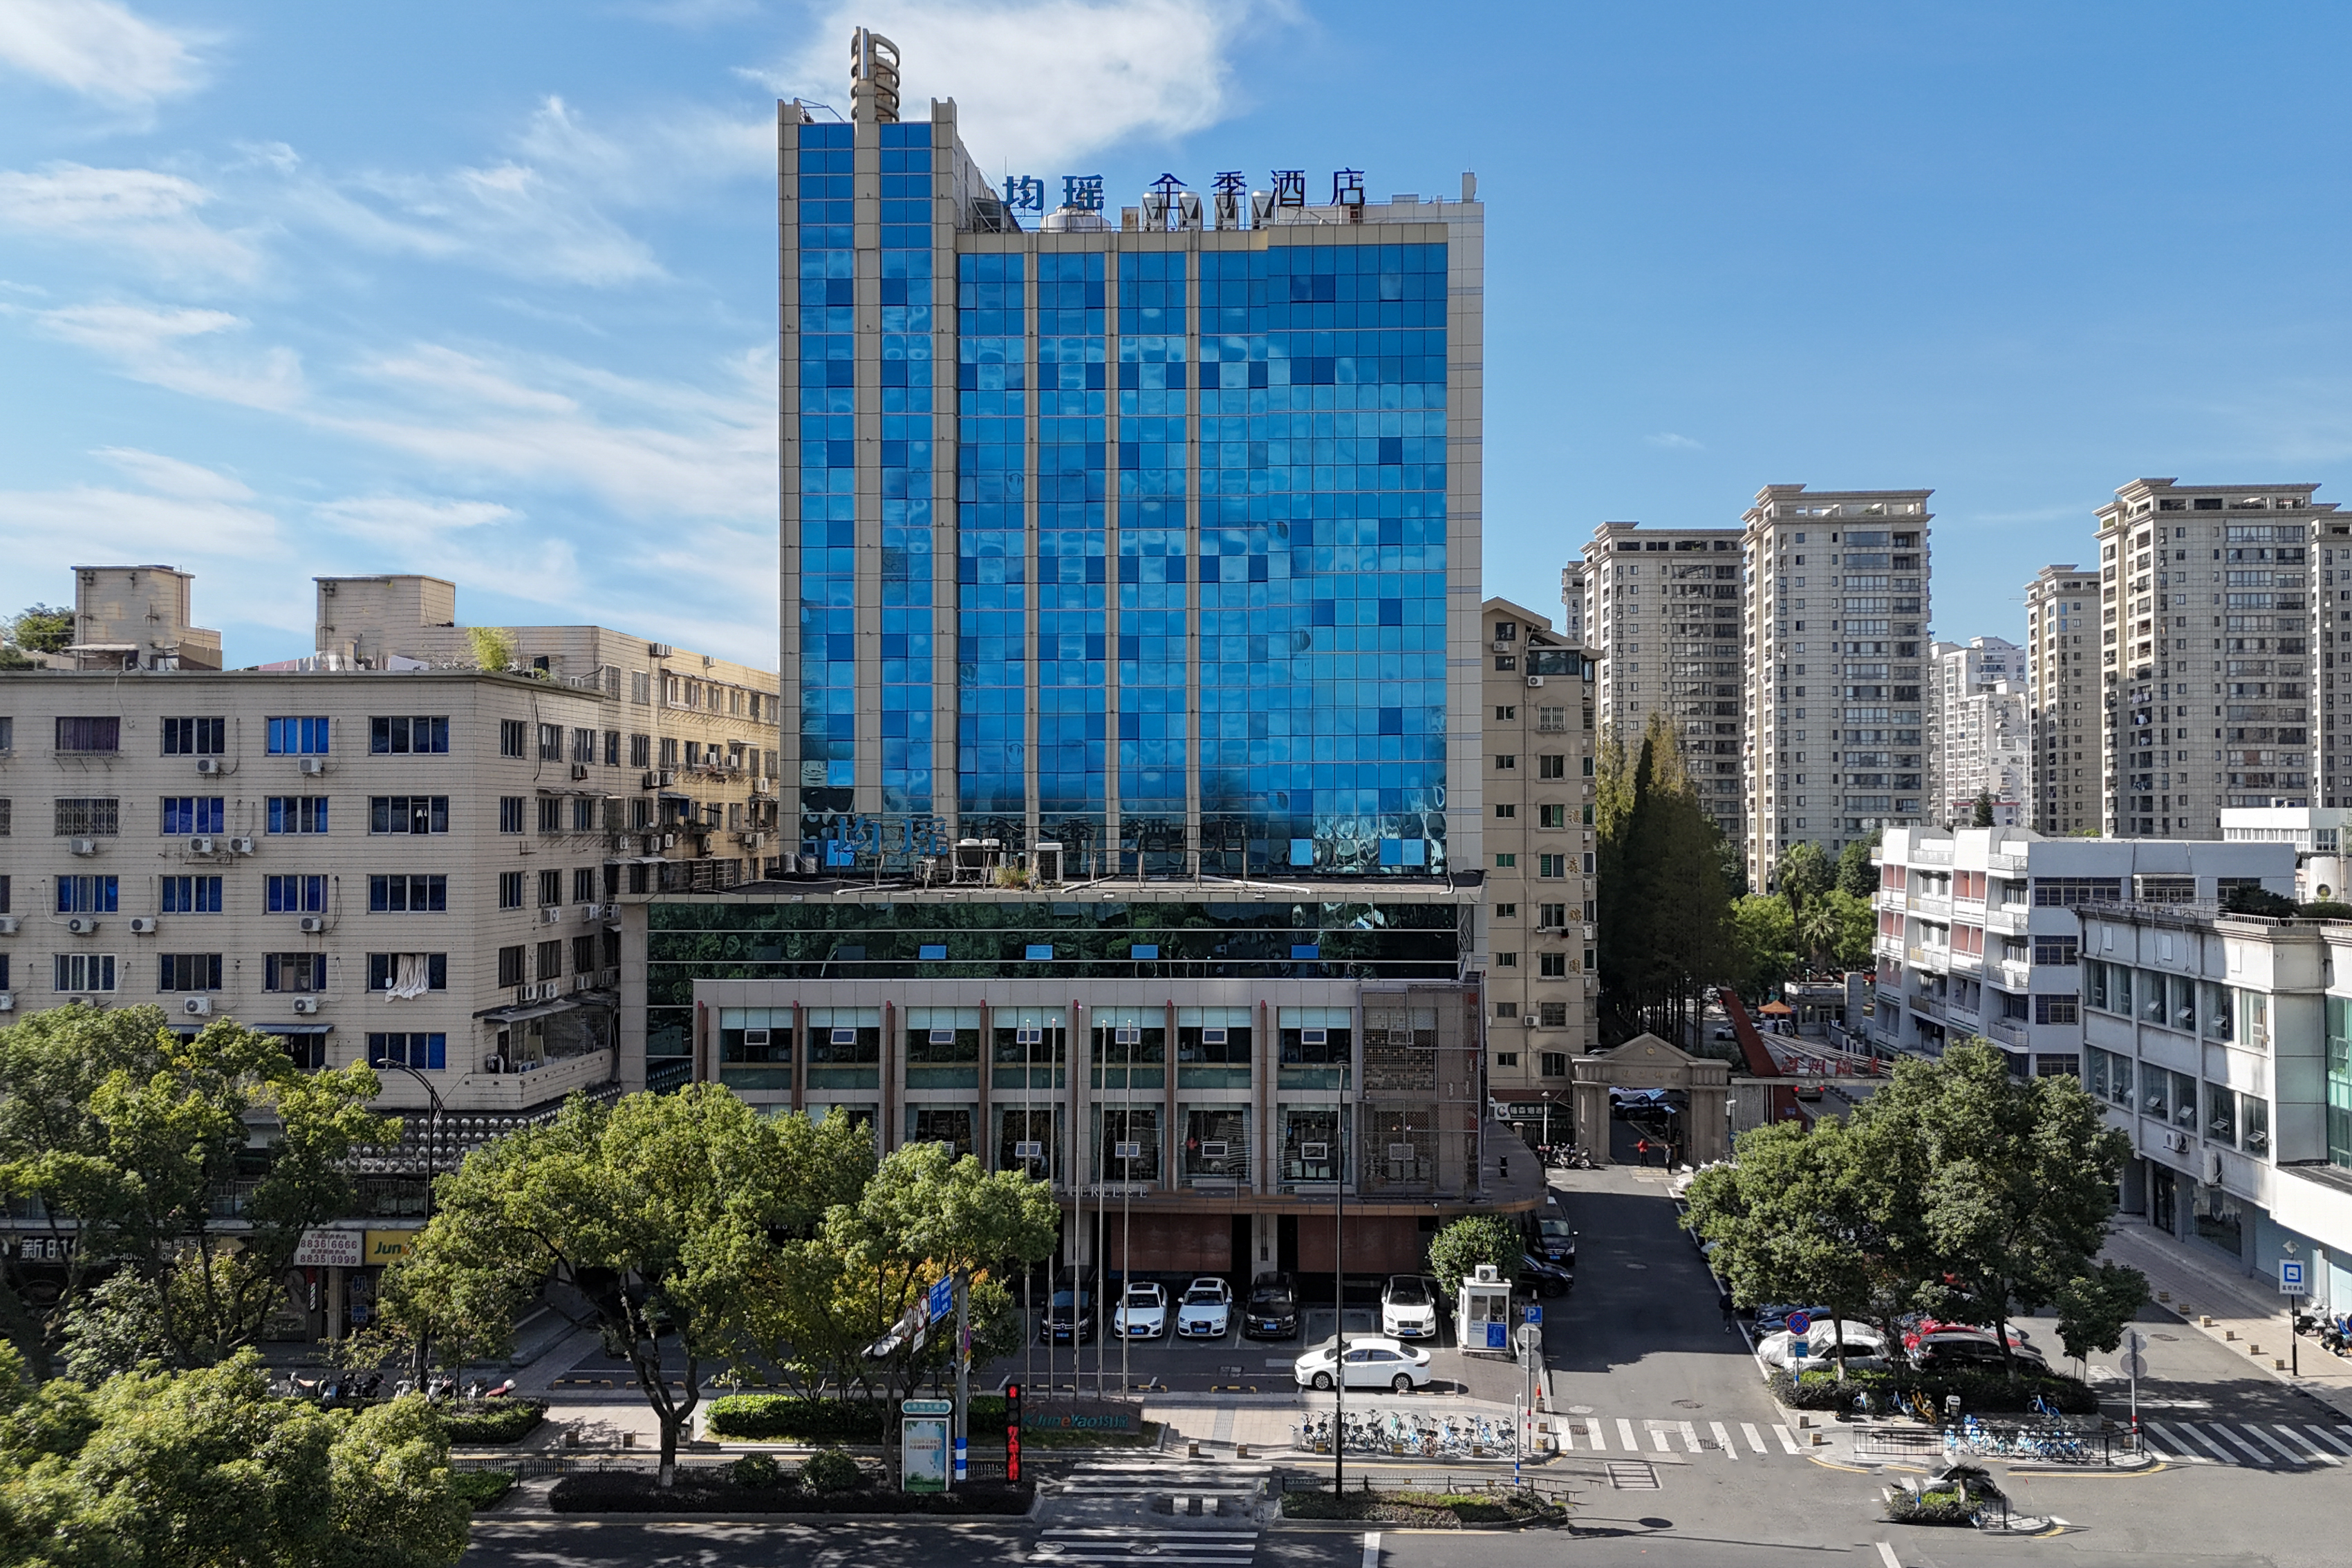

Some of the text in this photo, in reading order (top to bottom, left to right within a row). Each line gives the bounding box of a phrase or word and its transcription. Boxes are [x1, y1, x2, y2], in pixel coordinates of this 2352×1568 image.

[1002, 167, 1365, 209] 均瑶 全季酒店
[301, 1240, 357, 1249] 8836 6666
[300, 1254, 357, 1264] 8835 9999
[1527, 1308, 1537, 1320] P
[1035, 1414, 1097, 1428] JuneYao
